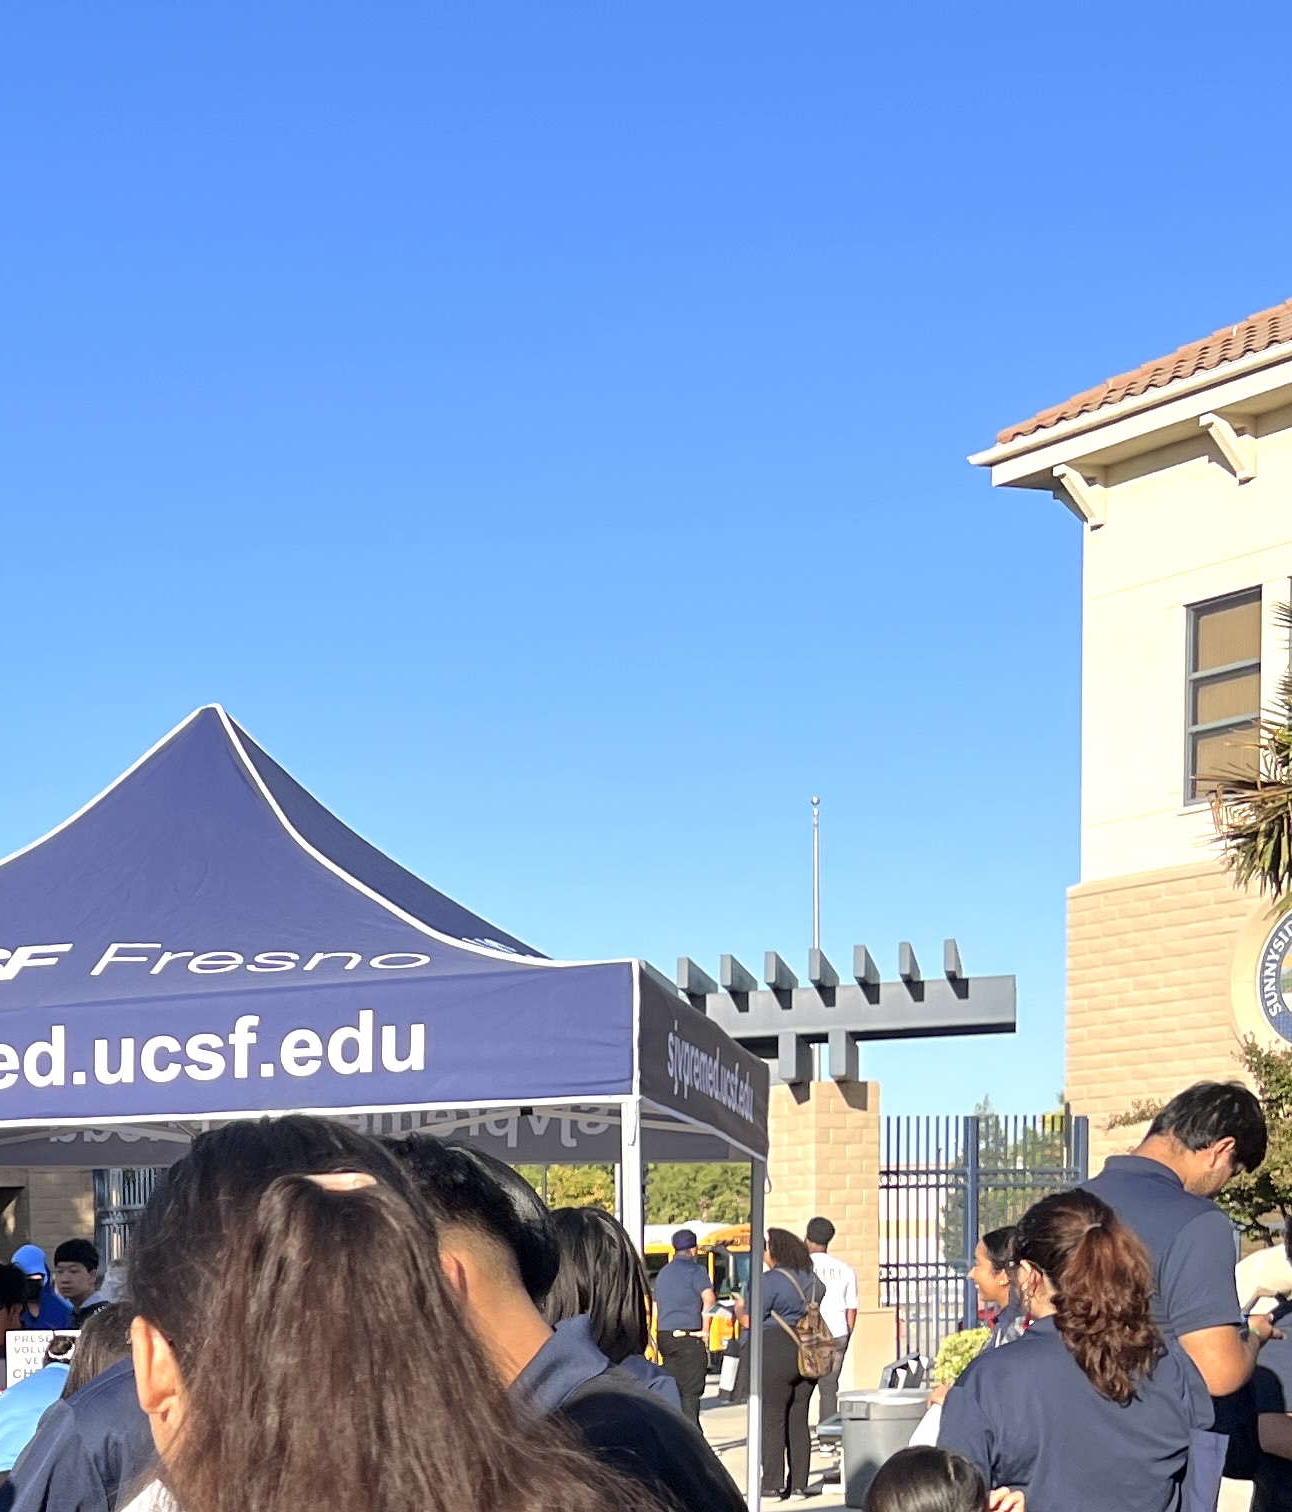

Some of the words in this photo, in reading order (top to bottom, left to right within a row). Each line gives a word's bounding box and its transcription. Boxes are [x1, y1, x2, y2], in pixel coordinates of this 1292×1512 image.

[90, 942, 431, 977] Fresno
[1263, 919, 1292, 1018] SUNNYSID
[14, 1334, 52, 1343] PRESE
[13, 1346, 46, 1354] VOLU
[24, 1357, 39, 1365] VE
[12, 1368, 34, 1379] CH
